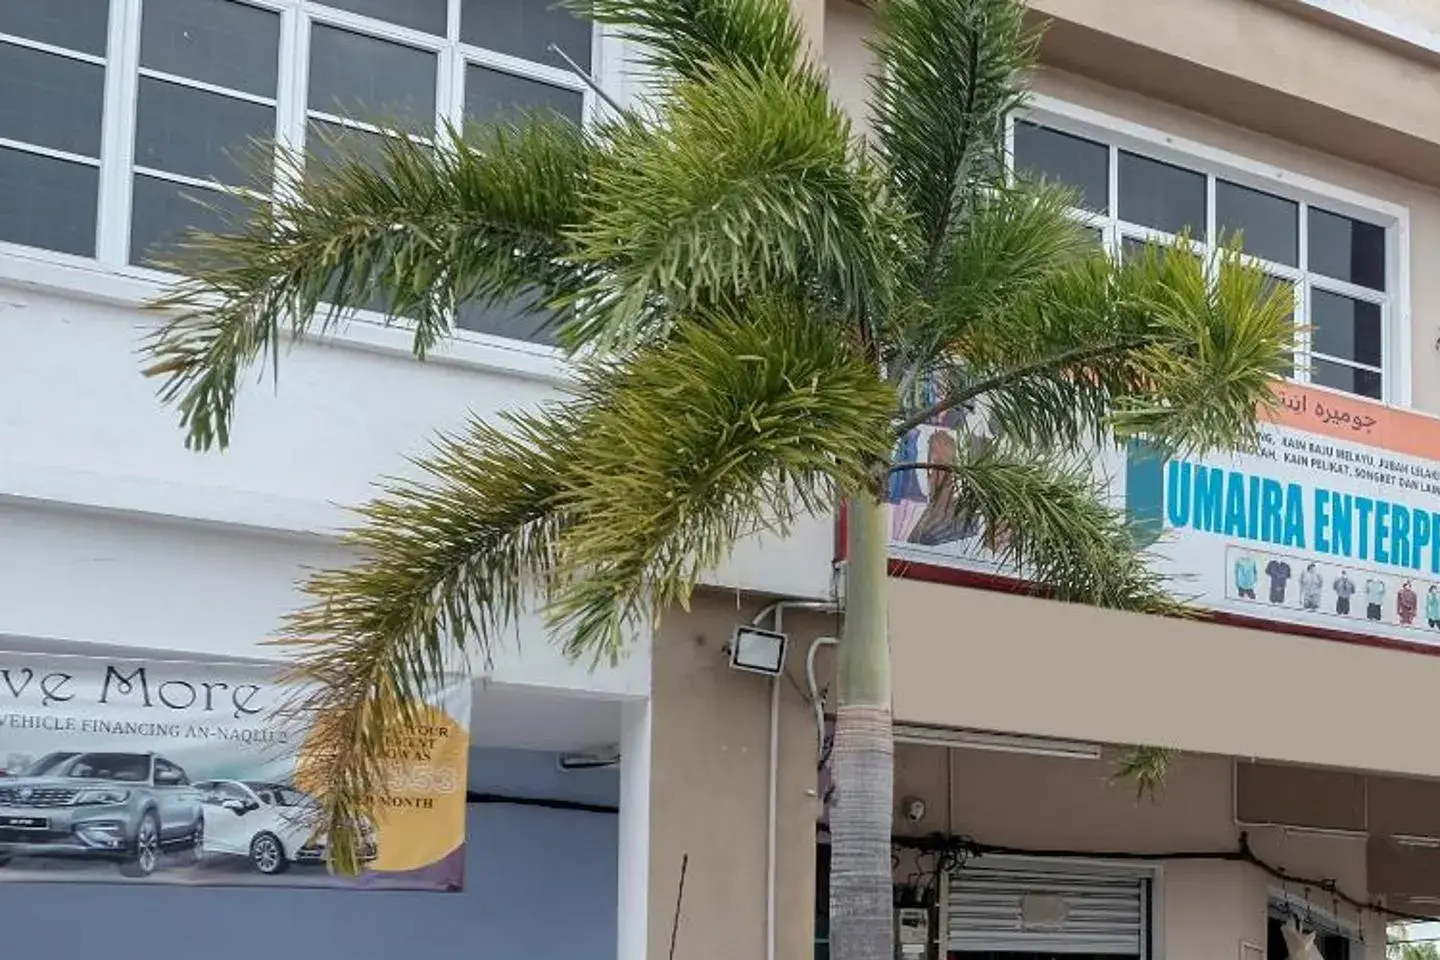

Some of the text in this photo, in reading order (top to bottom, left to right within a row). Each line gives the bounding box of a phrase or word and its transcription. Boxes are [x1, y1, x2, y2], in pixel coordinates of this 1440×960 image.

[1308, 442, 1333, 456] BAJU
[1283, 451, 1309, 468] KAIN
[1399, 477, 1419, 491] DAN
[98, 665, 263, 719] More
[82, 718, 180, 737] FINANCING
